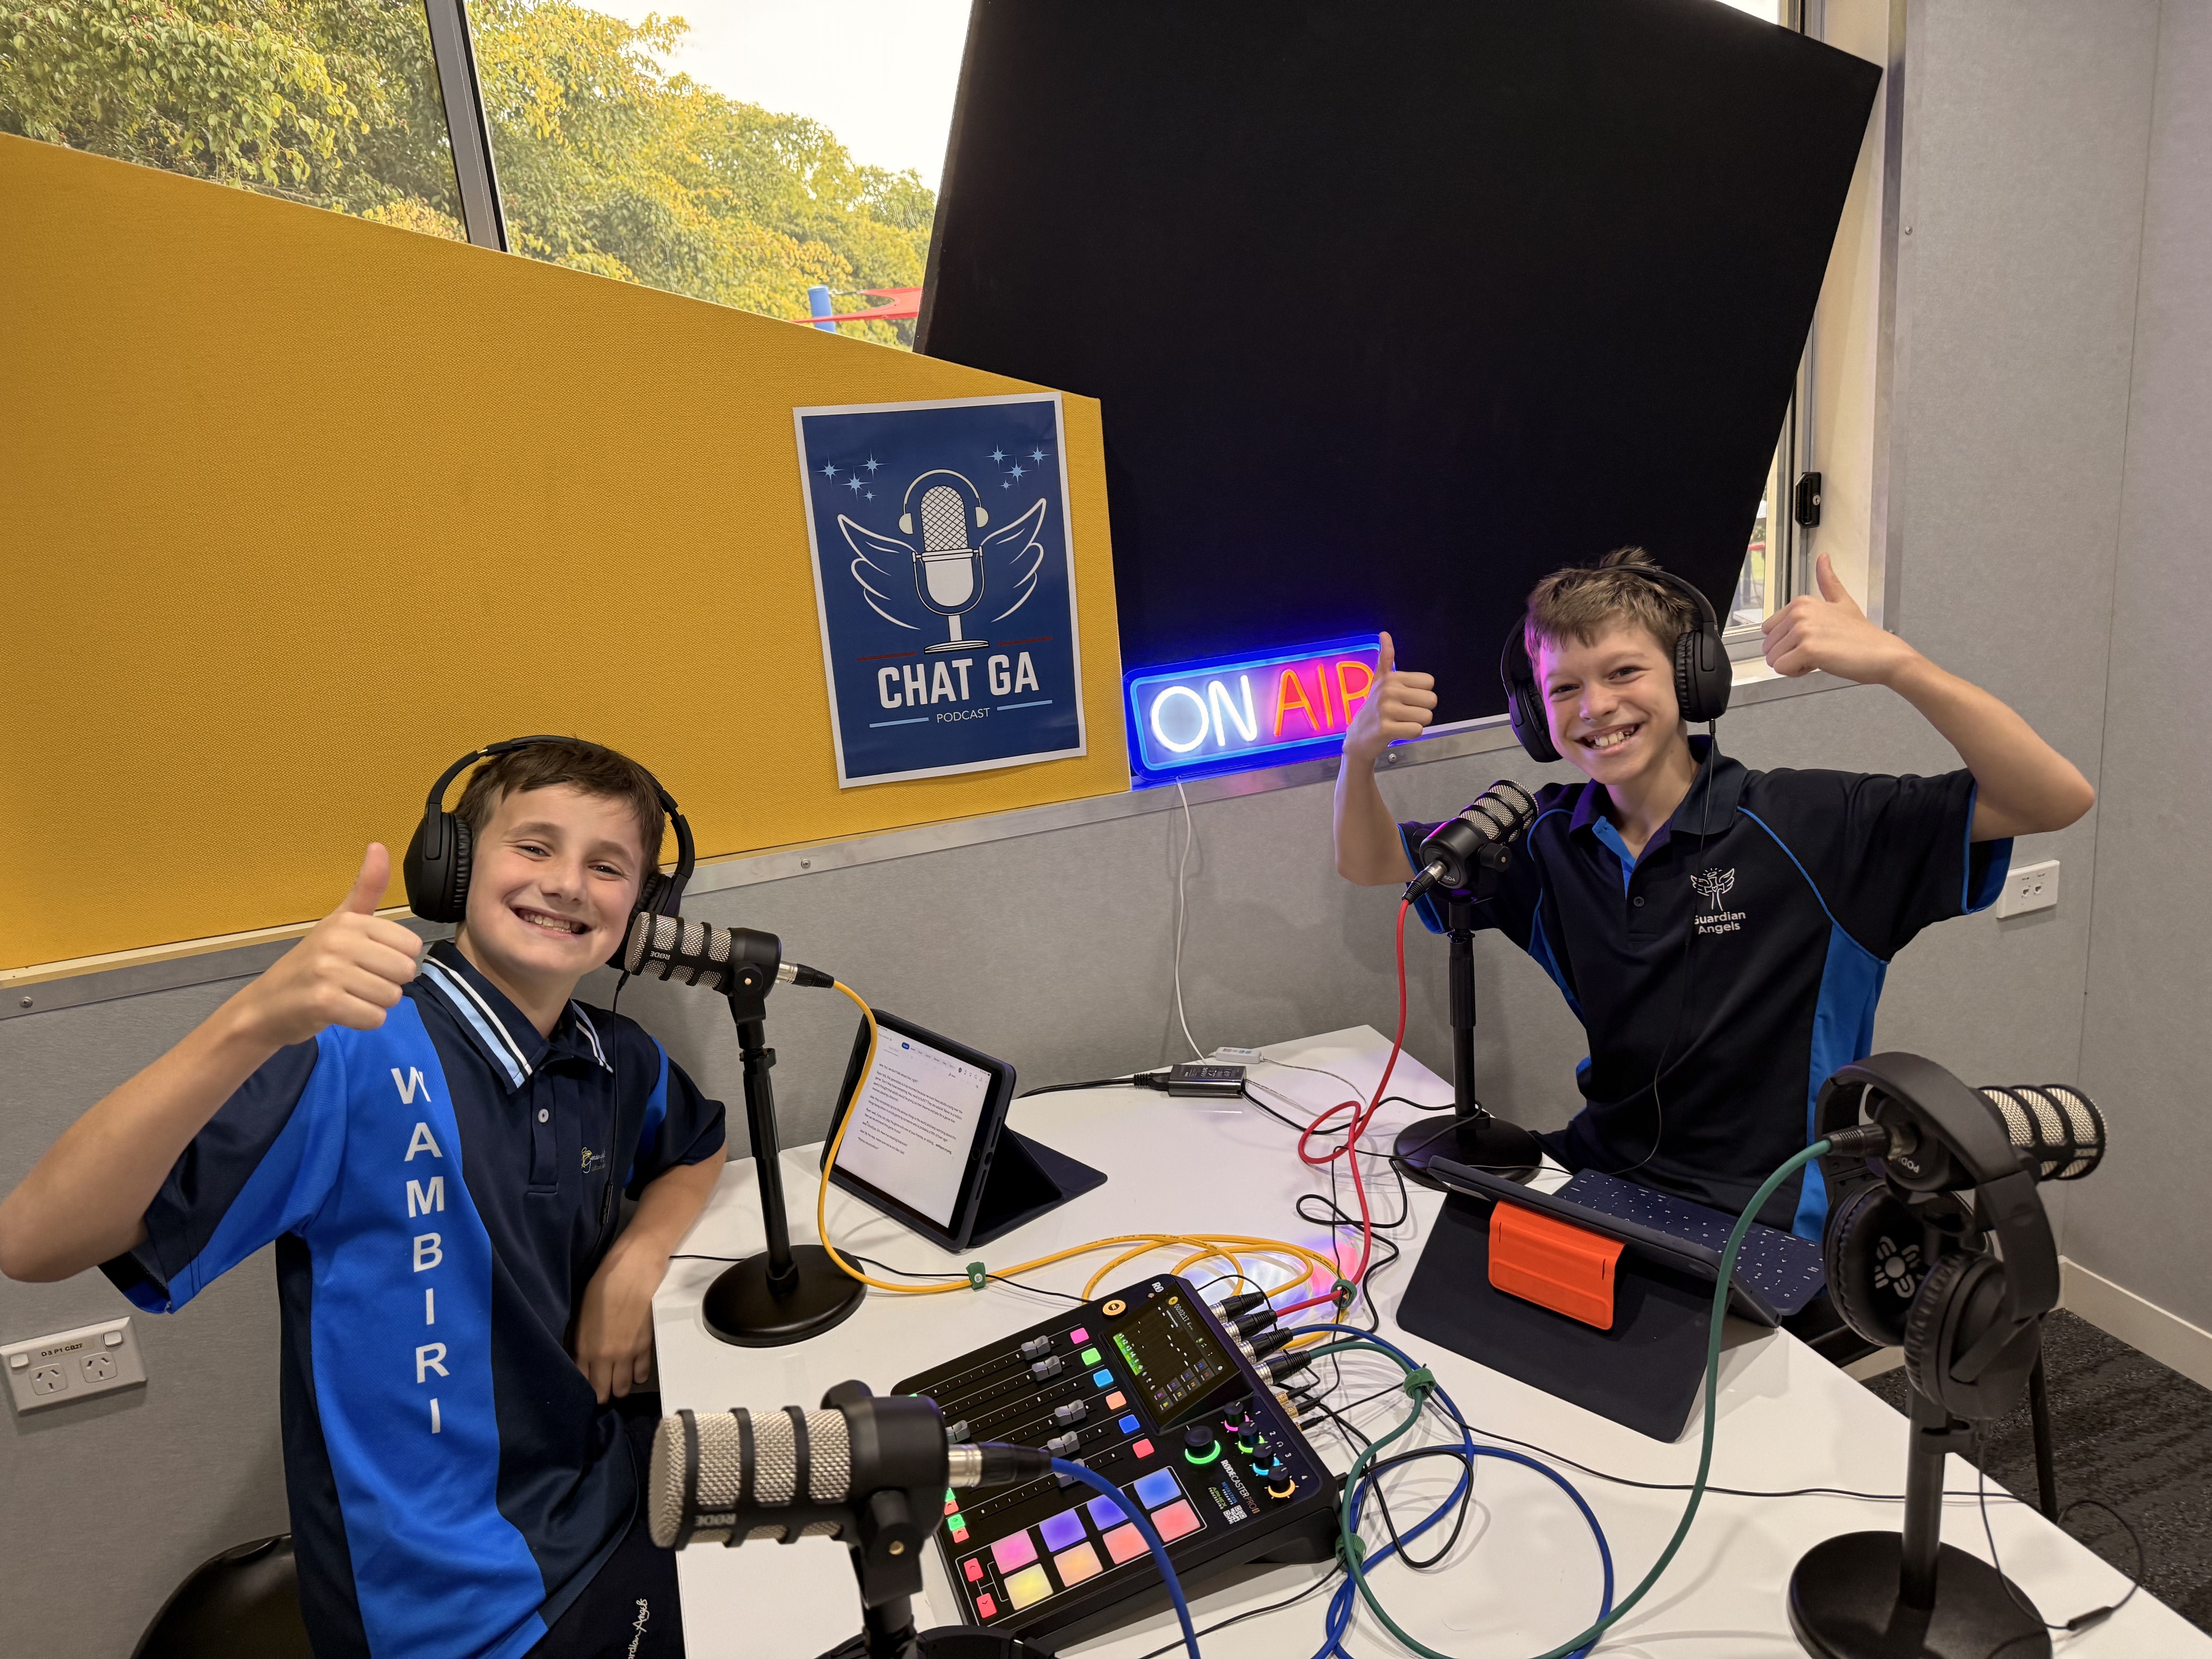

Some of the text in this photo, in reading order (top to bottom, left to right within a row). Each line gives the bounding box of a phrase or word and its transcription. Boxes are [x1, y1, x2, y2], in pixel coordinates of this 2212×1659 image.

[878, 651, 1039, 709] CHAT GA
[936, 708, 991, 723] PODCAST
[1151, 675, 1258, 752] ON
[1698, 921, 1741, 934] Angels
[1901, 1158, 1919, 1173] POD
[391, 1066, 449, 1434] WAMBIRI
[1152, 1281, 1164, 1293] RØ
[1245, 1496, 1256, 1509] PRO
[632, 1598, 650, 1632] Angels
